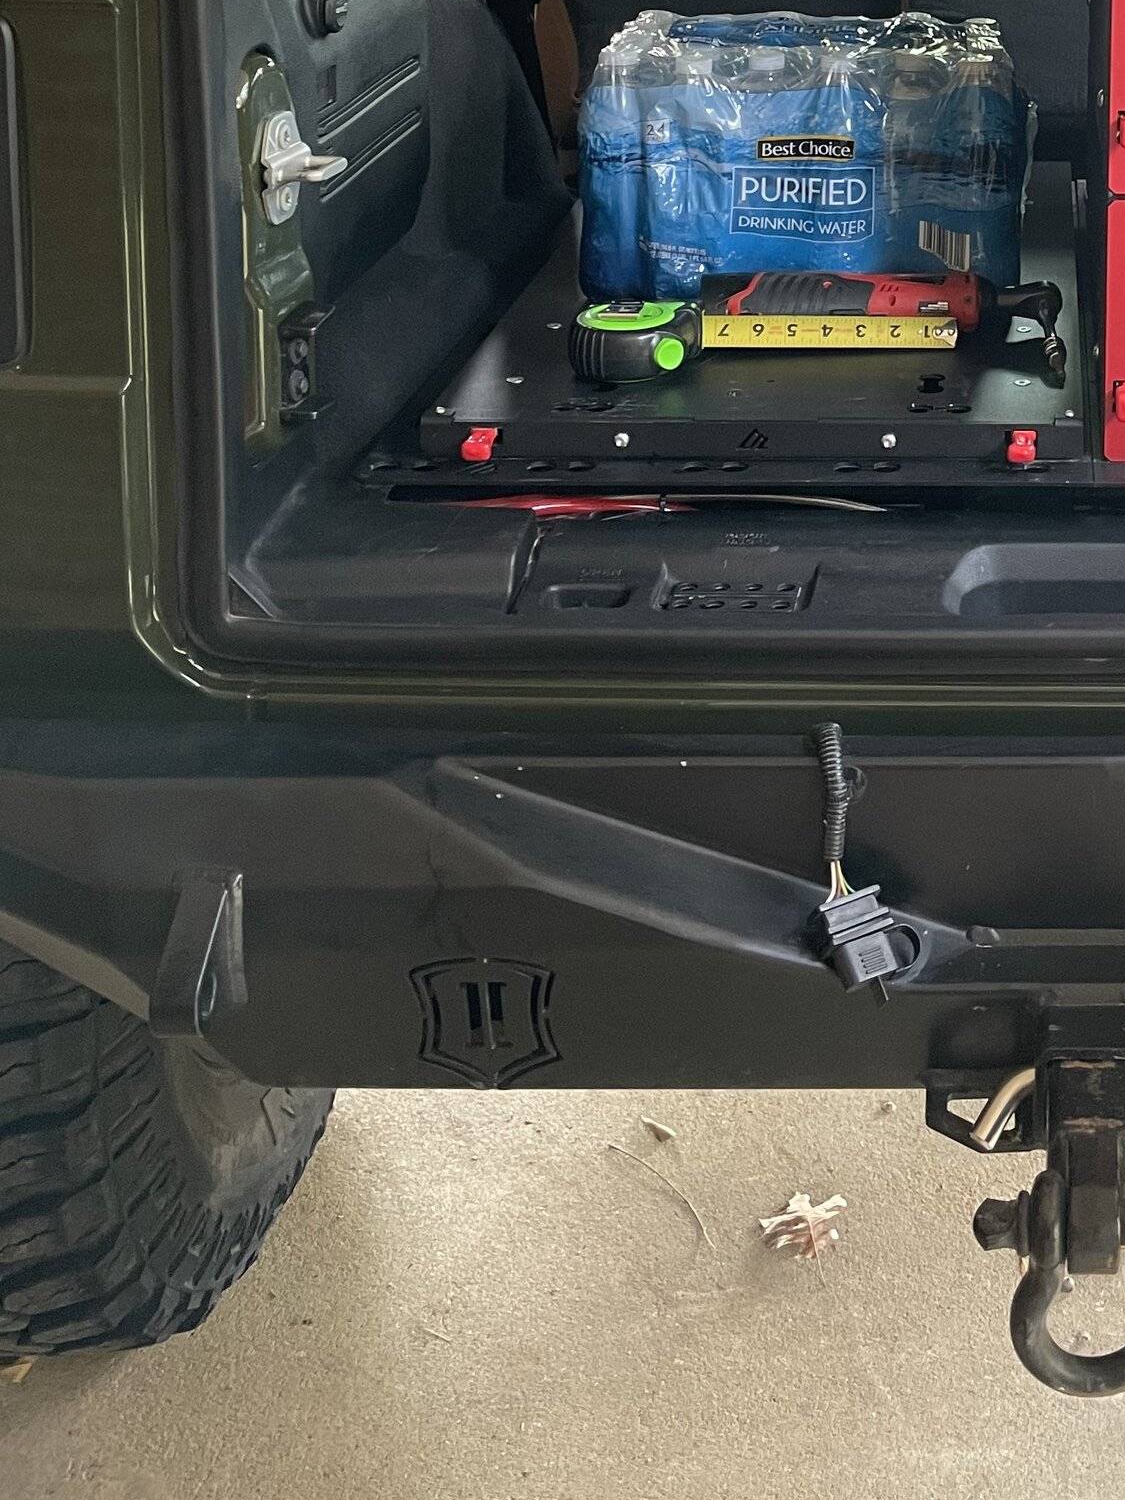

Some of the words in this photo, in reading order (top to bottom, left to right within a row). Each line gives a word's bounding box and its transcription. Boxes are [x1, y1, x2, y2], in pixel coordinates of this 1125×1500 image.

[761, 141, 797, 157] Best
[798, 140, 851, 157] Choice
[740, 176, 867, 206] PURIFIED
[738, 215, 814, 234] DRINKING
[817, 220, 866, 237] WATER
[717, 323, 730, 337] 7
[752, 323, 765, 337] 6
[787, 324, 798, 337] 5
[821, 323, 834, 338] 4
[856, 324, 867, 338] 3
[890, 324, 901, 338] 2
